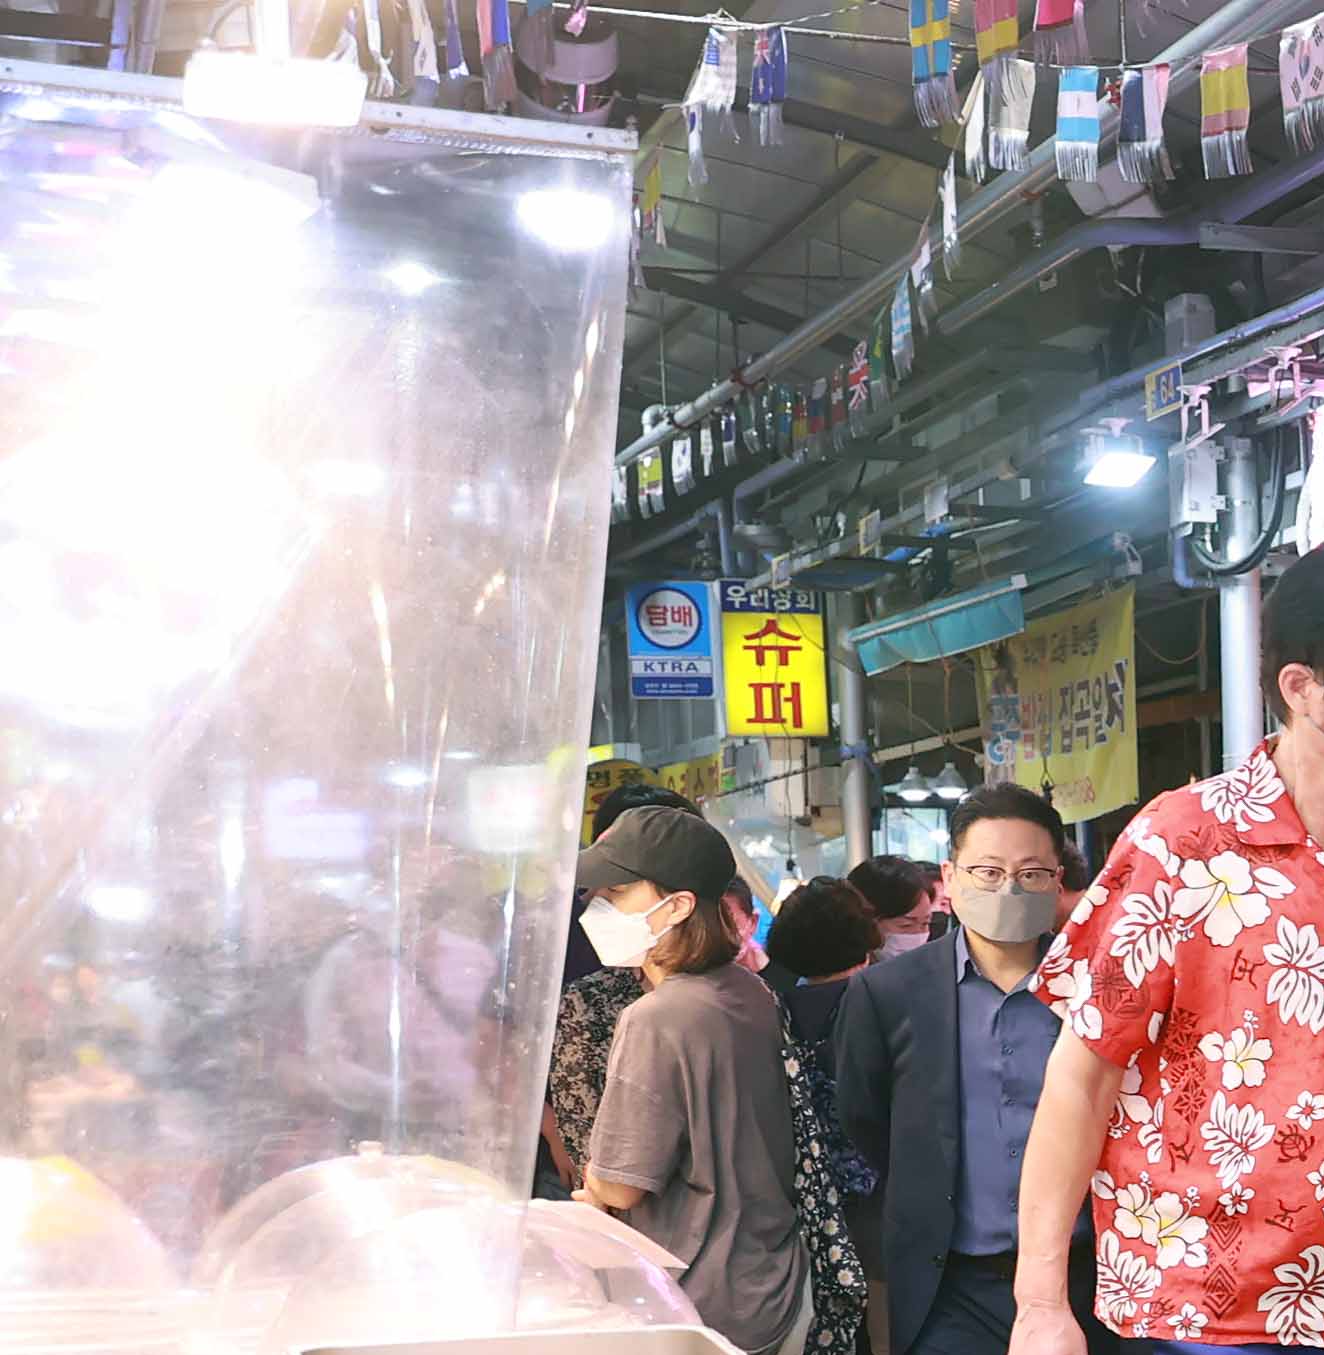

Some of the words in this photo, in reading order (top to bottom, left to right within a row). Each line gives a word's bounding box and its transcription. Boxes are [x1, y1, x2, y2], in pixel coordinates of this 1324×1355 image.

[645, 604, 693, 628] 담배
[643, 661, 698, 673] KTRA
[742, 618, 803, 729] 슈퍼
